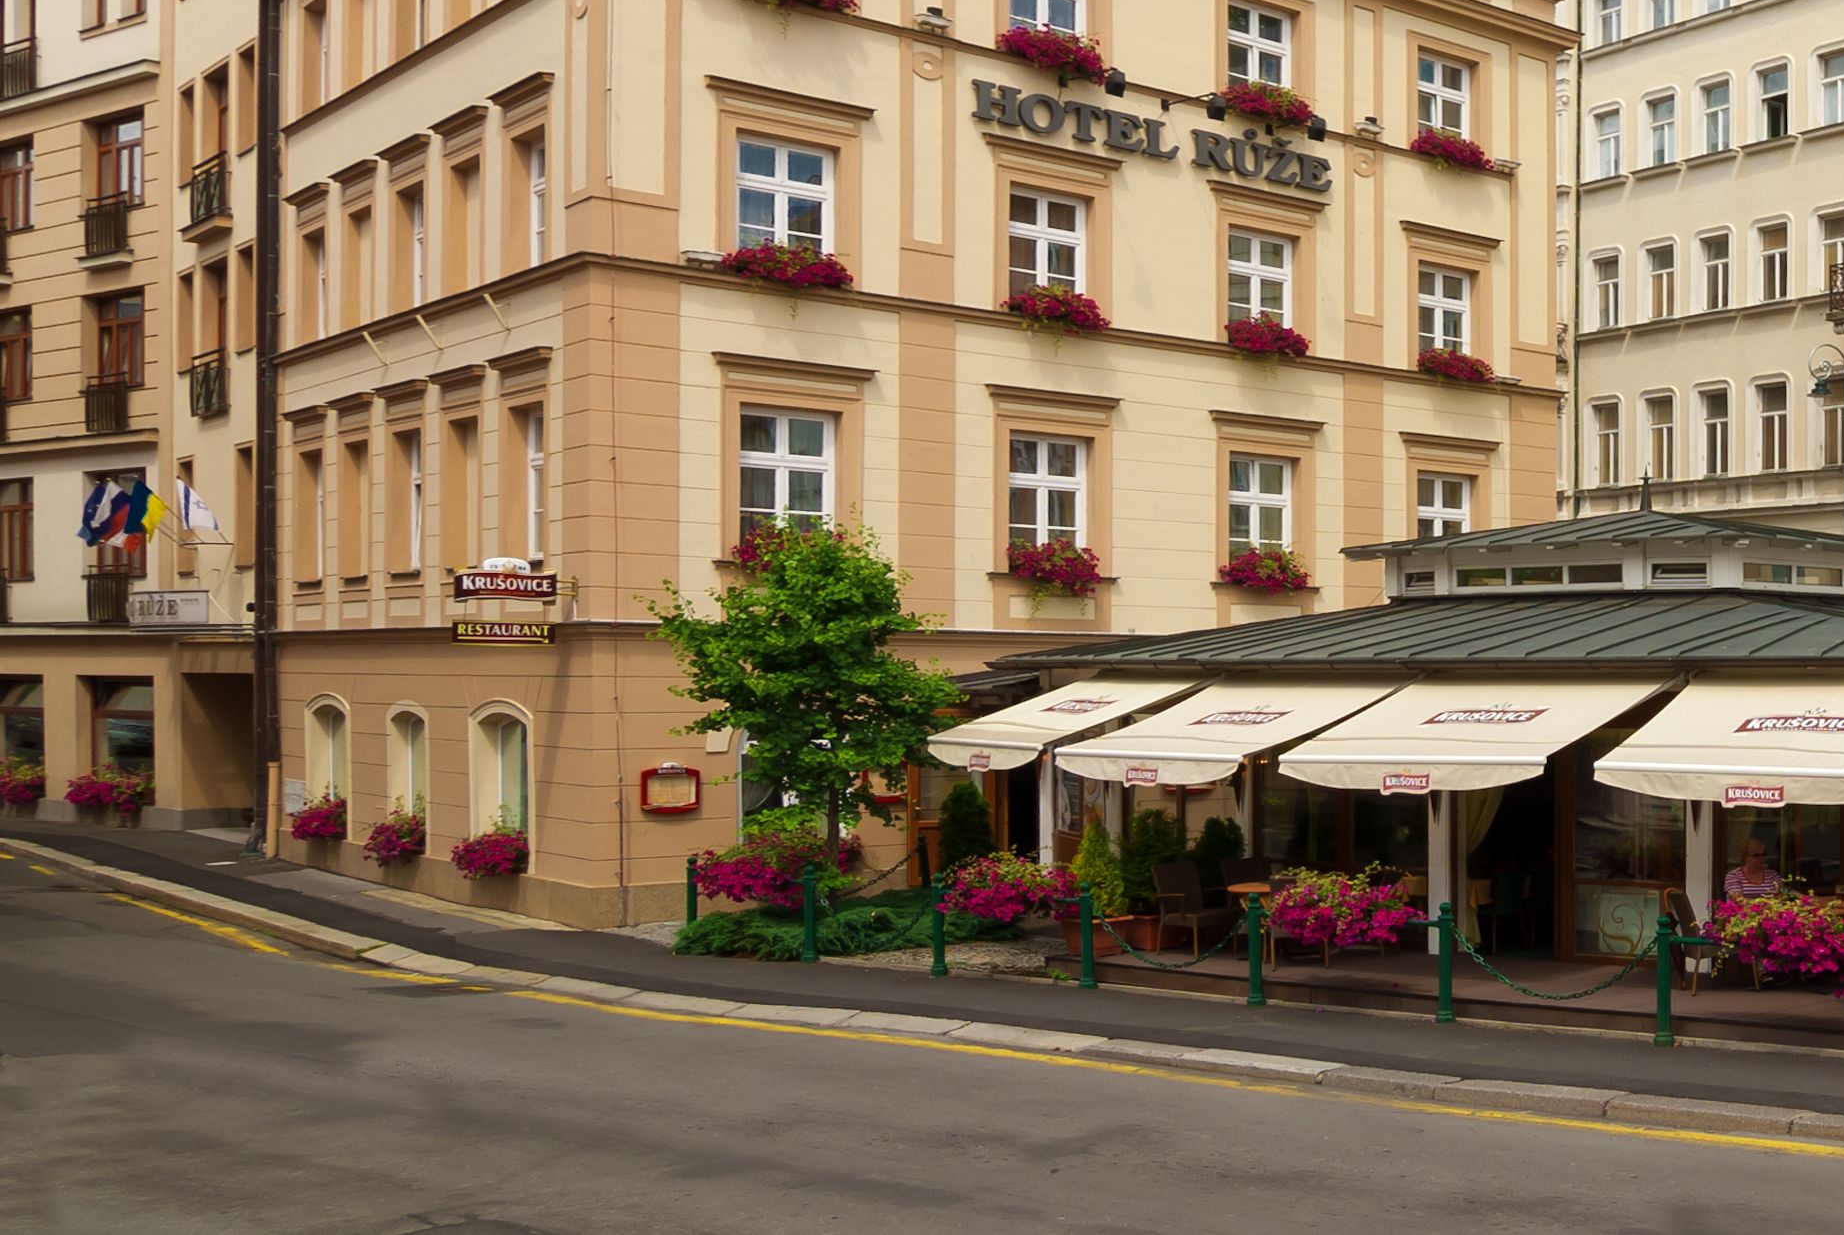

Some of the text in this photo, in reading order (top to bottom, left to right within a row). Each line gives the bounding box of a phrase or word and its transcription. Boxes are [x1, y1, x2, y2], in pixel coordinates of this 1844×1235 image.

[971, 78, 1333, 193] HOTEL RŮŽE
[461, 574, 553, 593] KRUŠOVICE
[457, 623, 551, 637] RESTAURANT
[1432, 710, 1537, 722] KRUŠOVICE
[1727, 787, 1780, 800] KRUŠOVICE
